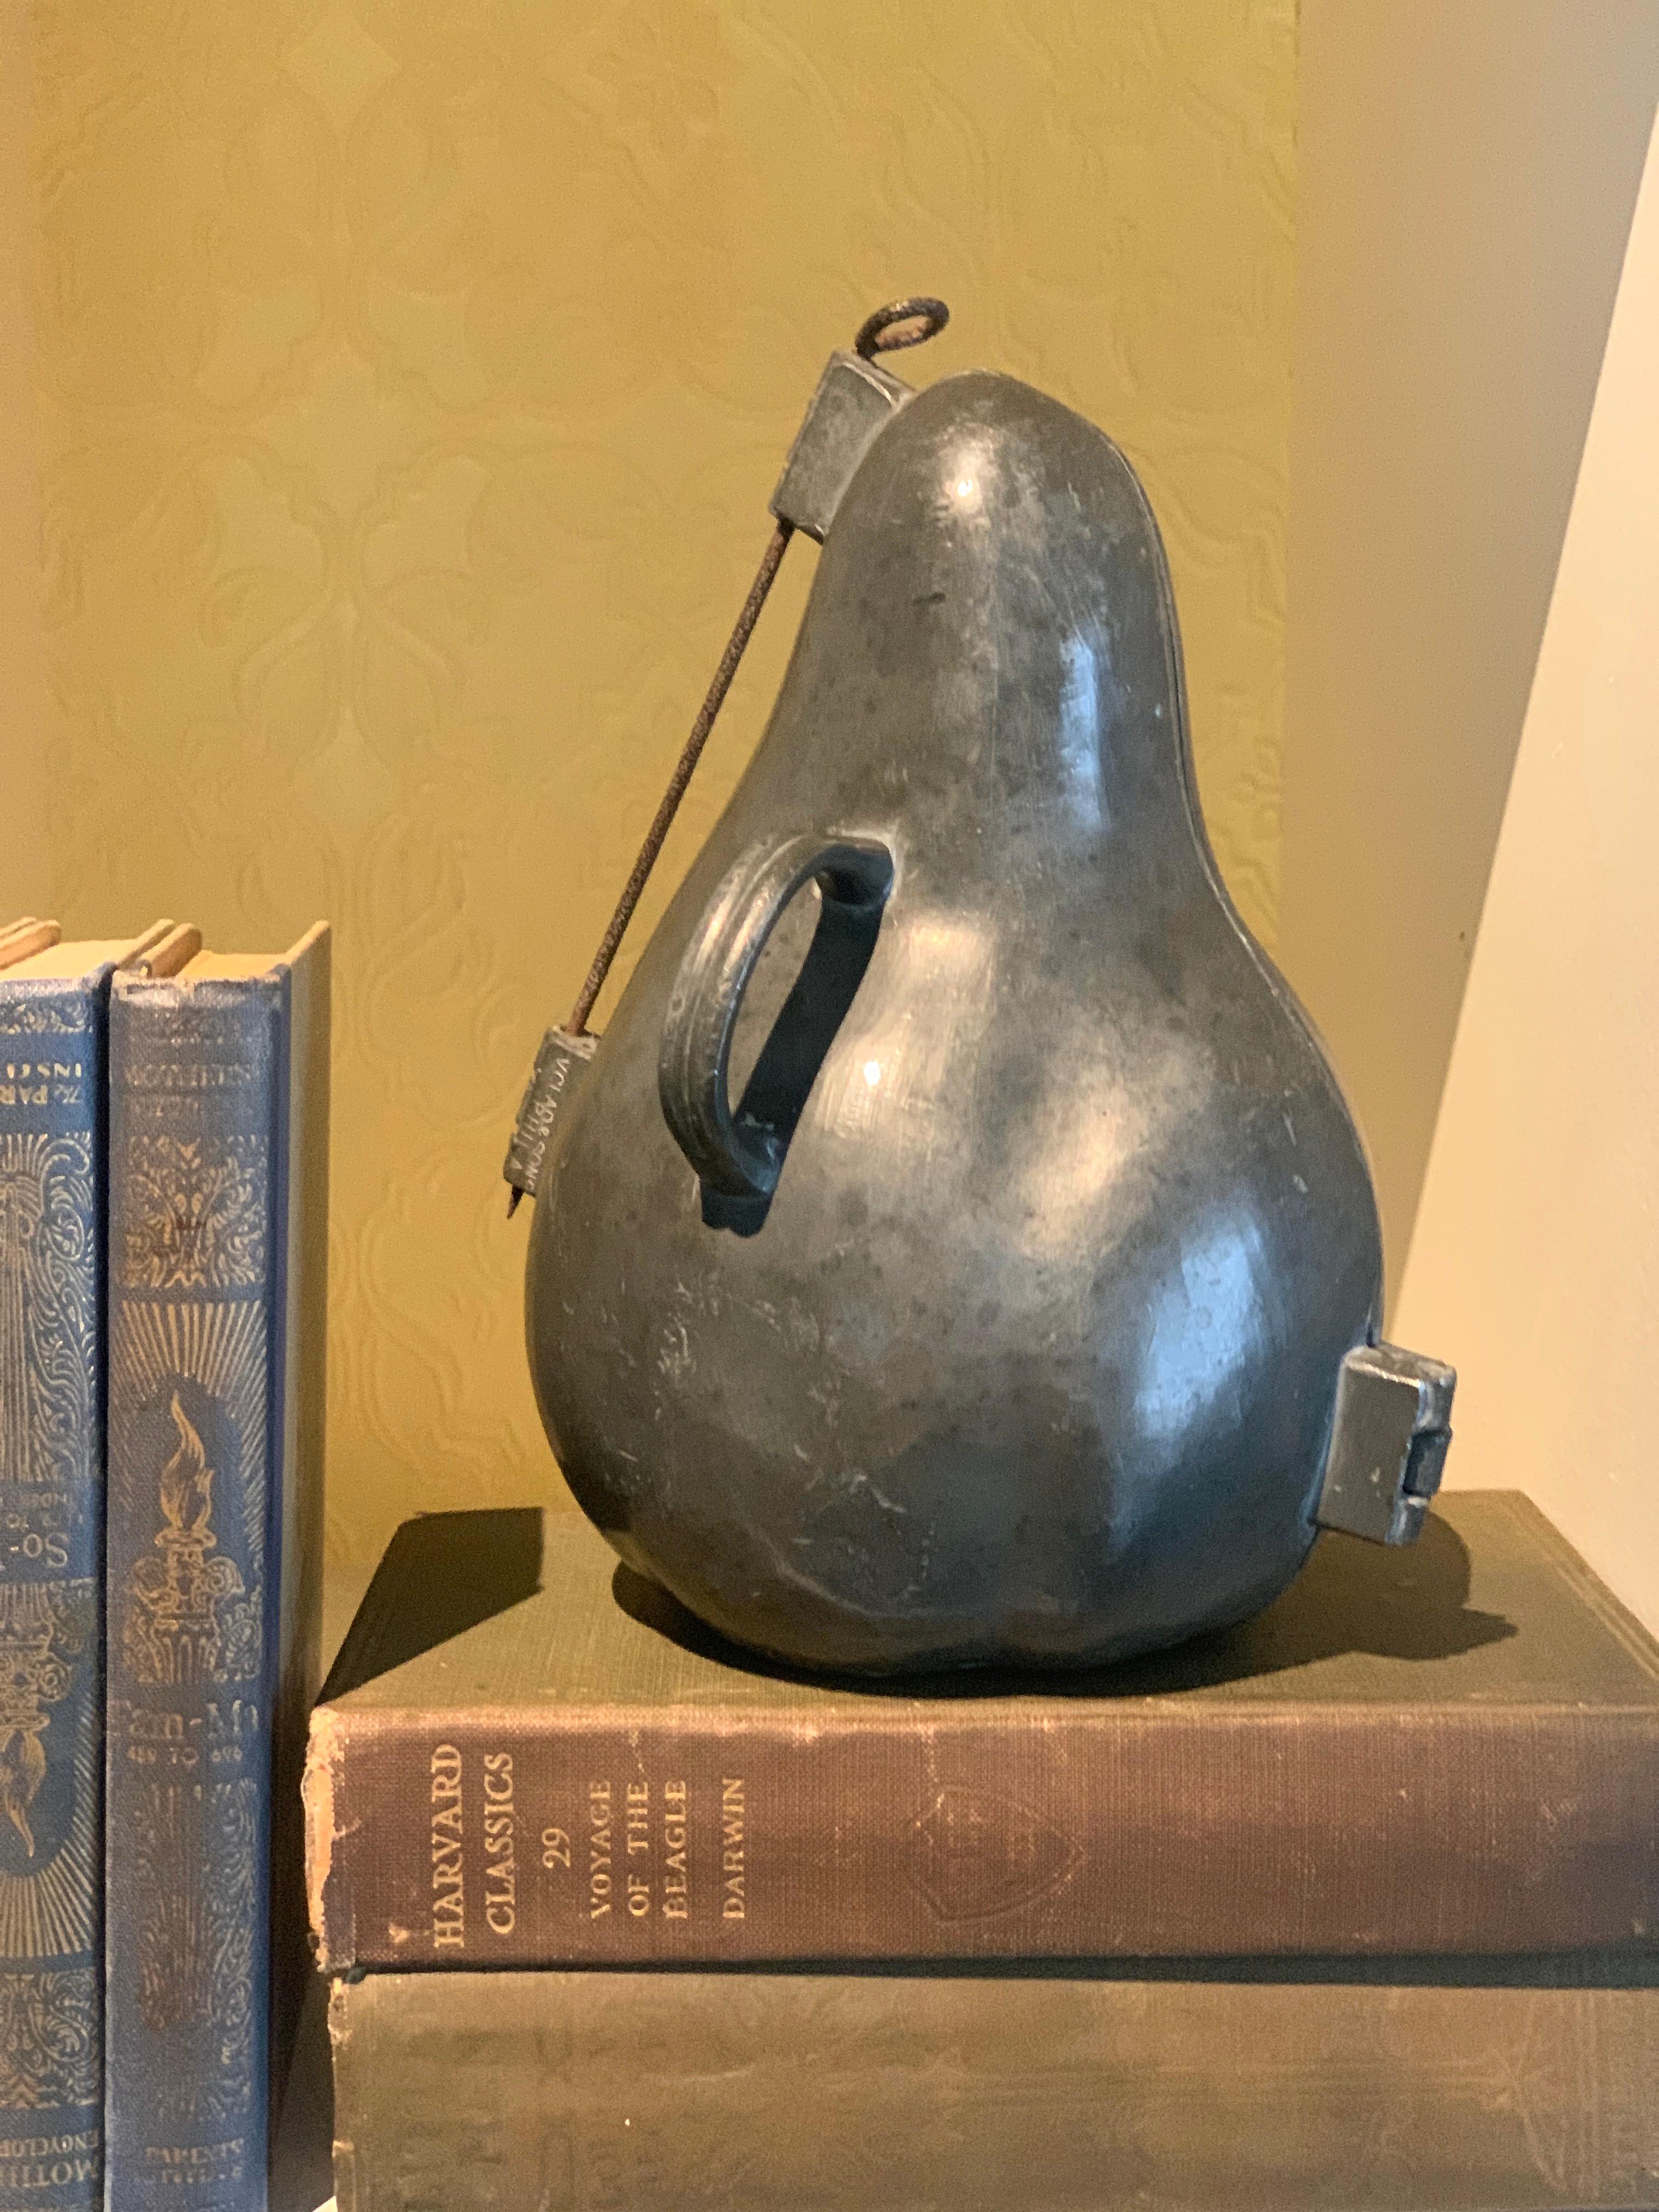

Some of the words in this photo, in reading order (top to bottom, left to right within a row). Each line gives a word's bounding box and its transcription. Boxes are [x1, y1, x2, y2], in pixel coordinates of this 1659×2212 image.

[432, 1744, 464, 1948] HARVARD
[484, 1753, 515, 1934] CLASSICS
[542, 1828, 570, 1869] 29
[590, 1780, 611, 1919] VOYAGE
[628, 1781, 649, 1855] THE
[662, 1780, 688, 1920] BEAGLE
[723, 1778, 744, 1918] DARWIN
[628, 1874, 650, 1916] OF
